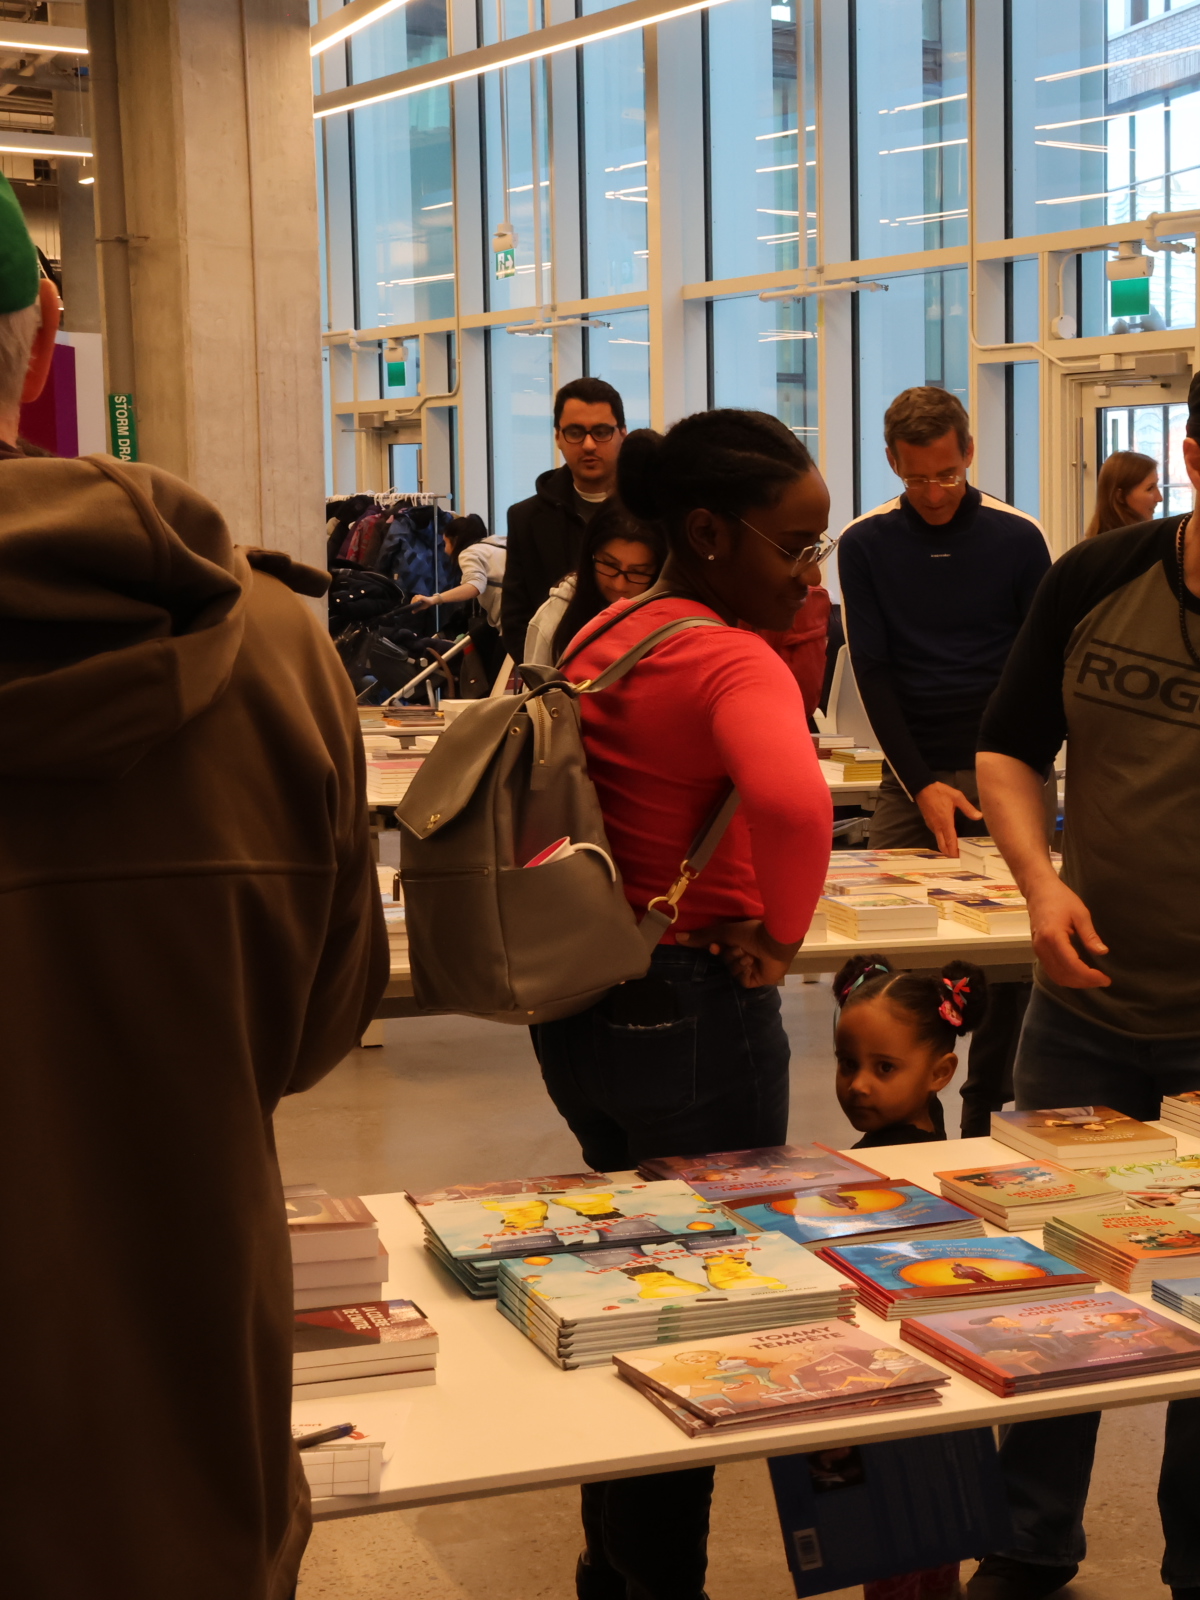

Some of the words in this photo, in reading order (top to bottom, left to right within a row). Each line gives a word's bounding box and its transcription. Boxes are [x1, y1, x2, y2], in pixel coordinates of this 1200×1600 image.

[114, 395, 129, 435] STORM
[118, 439, 131, 461] DRA
[631, 1247, 687, 1260] Léo
[1017, 1301, 1114, 1319] COQUELICOT
[1022, 1304, 1045, 1313] UN
[1050, 1298, 1097, 1310] BISOU
[749, 1330, 846, 1351] TEMPÊTE
[752, 1326, 833, 1343] TOMMY
